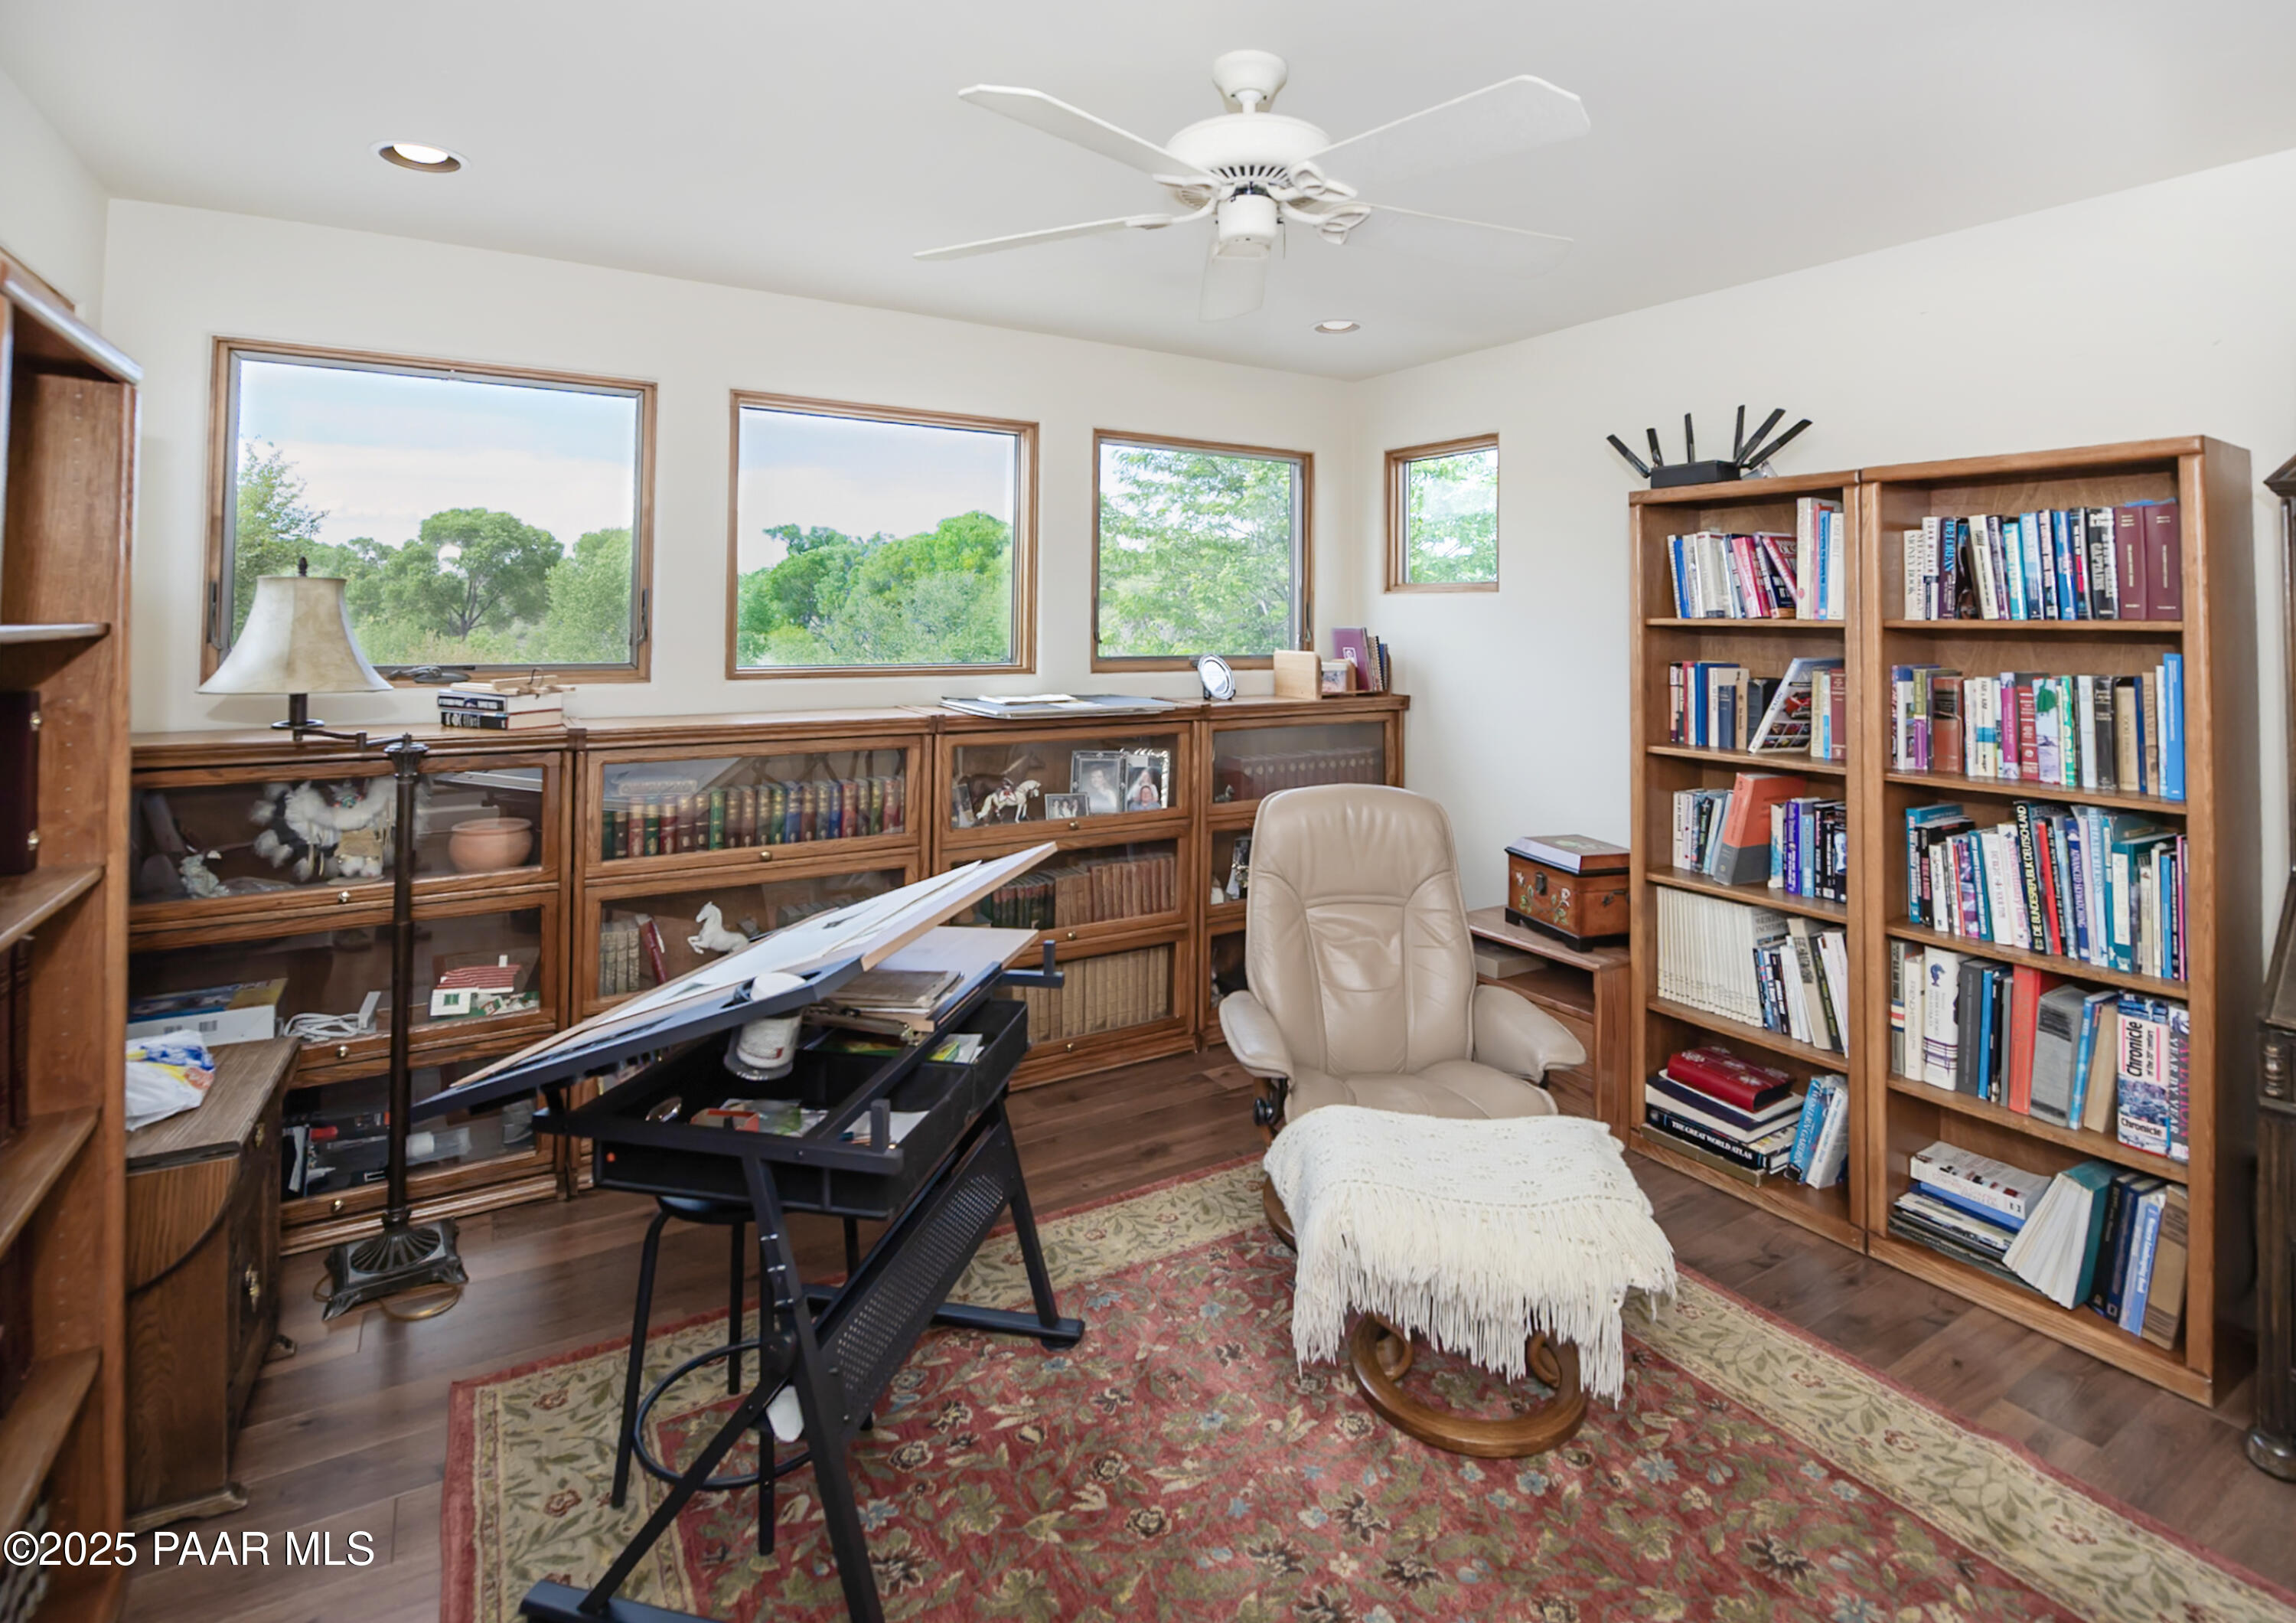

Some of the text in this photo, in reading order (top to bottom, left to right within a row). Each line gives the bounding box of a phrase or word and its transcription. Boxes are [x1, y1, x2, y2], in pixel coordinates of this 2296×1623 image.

[1945, 521, 1954, 571] DELOREAN
[2090, 542, 2105, 591] CAPTAINS
[1769, 691, 1784, 711] NOVA
[2007, 840, 2024, 904] Extraordinary
[2017, 805, 2043, 937] DIE BUNDESREPUBLIK DEUTSCHLAND
[2070, 849, 2087, 928] ADVANCED SKYWATCHING
[2125, 1020, 2142, 1077] Chronicle
[2169, 1037, 2179, 1135] YEAR BY YEAR
[2179, 1038, 2189, 1138] AVIATION
[1671, 1121, 1753, 1160] THE GREAT WORLD ATLAS
[1794, 1089, 1820, 1165] WESTERN GARDEN
[2121, 1117, 2162, 1138] Chronicle
